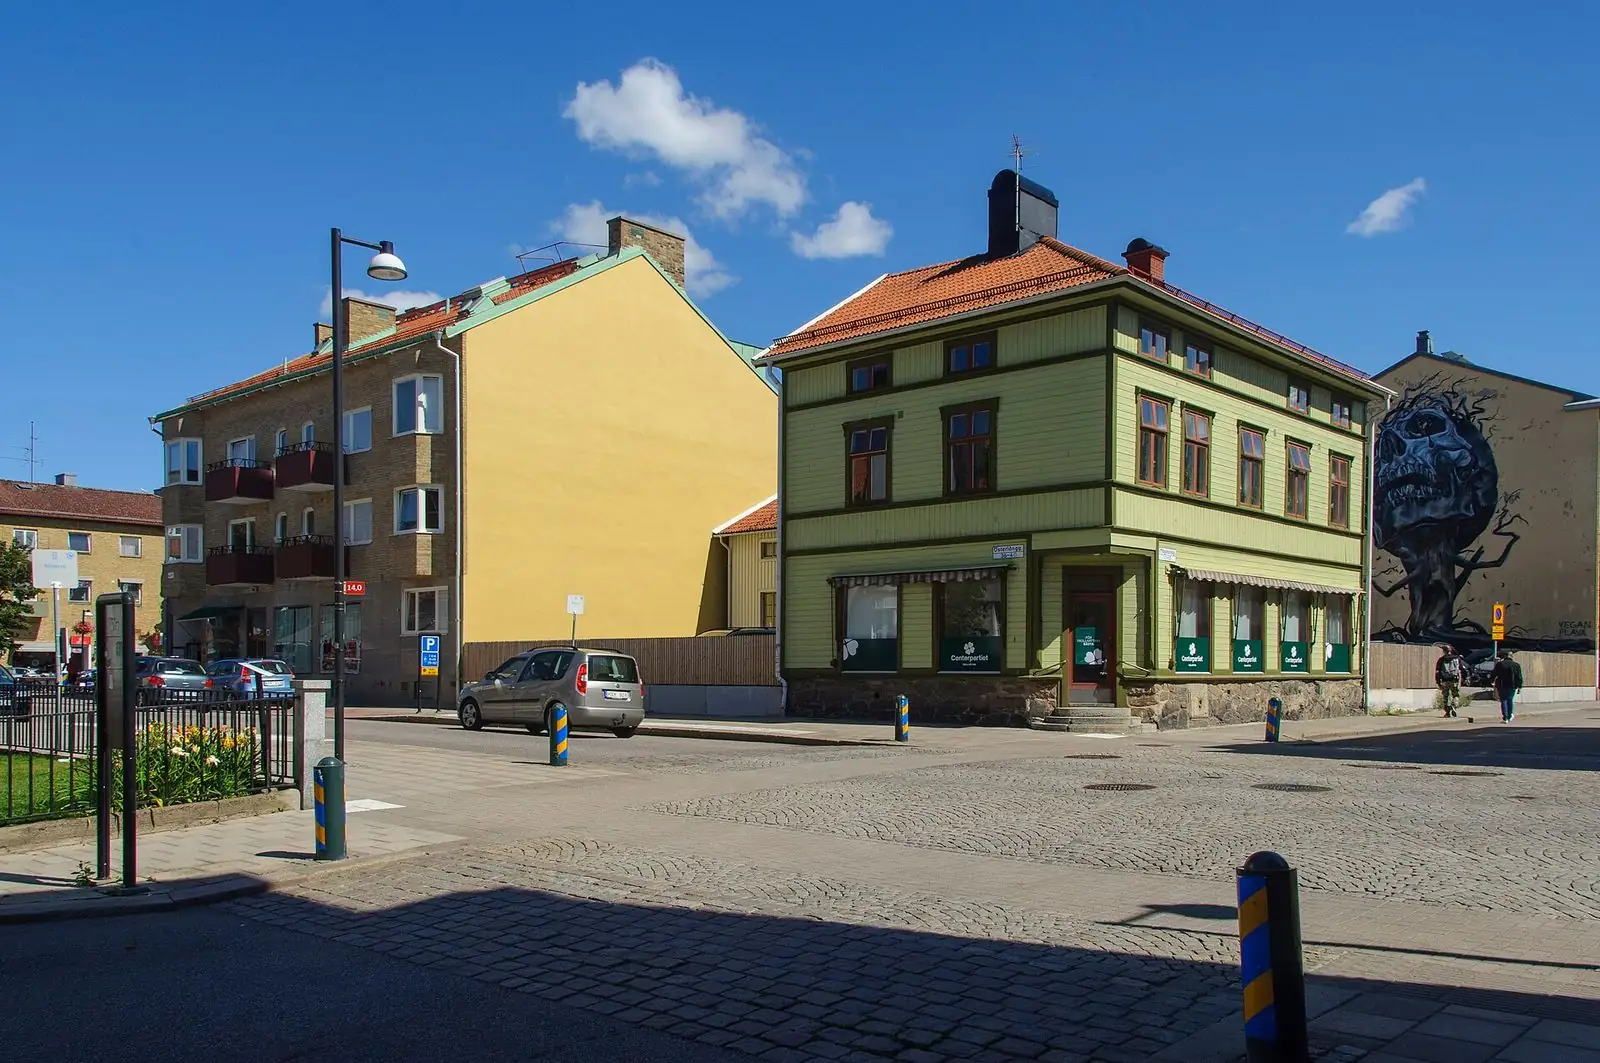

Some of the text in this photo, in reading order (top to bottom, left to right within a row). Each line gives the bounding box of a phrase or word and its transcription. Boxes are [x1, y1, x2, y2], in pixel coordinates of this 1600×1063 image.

[1558, 620, 1592, 629] VEGAN
[426, 638, 435, 651] P
[950, 654, 989, 662] Centerpartiet
